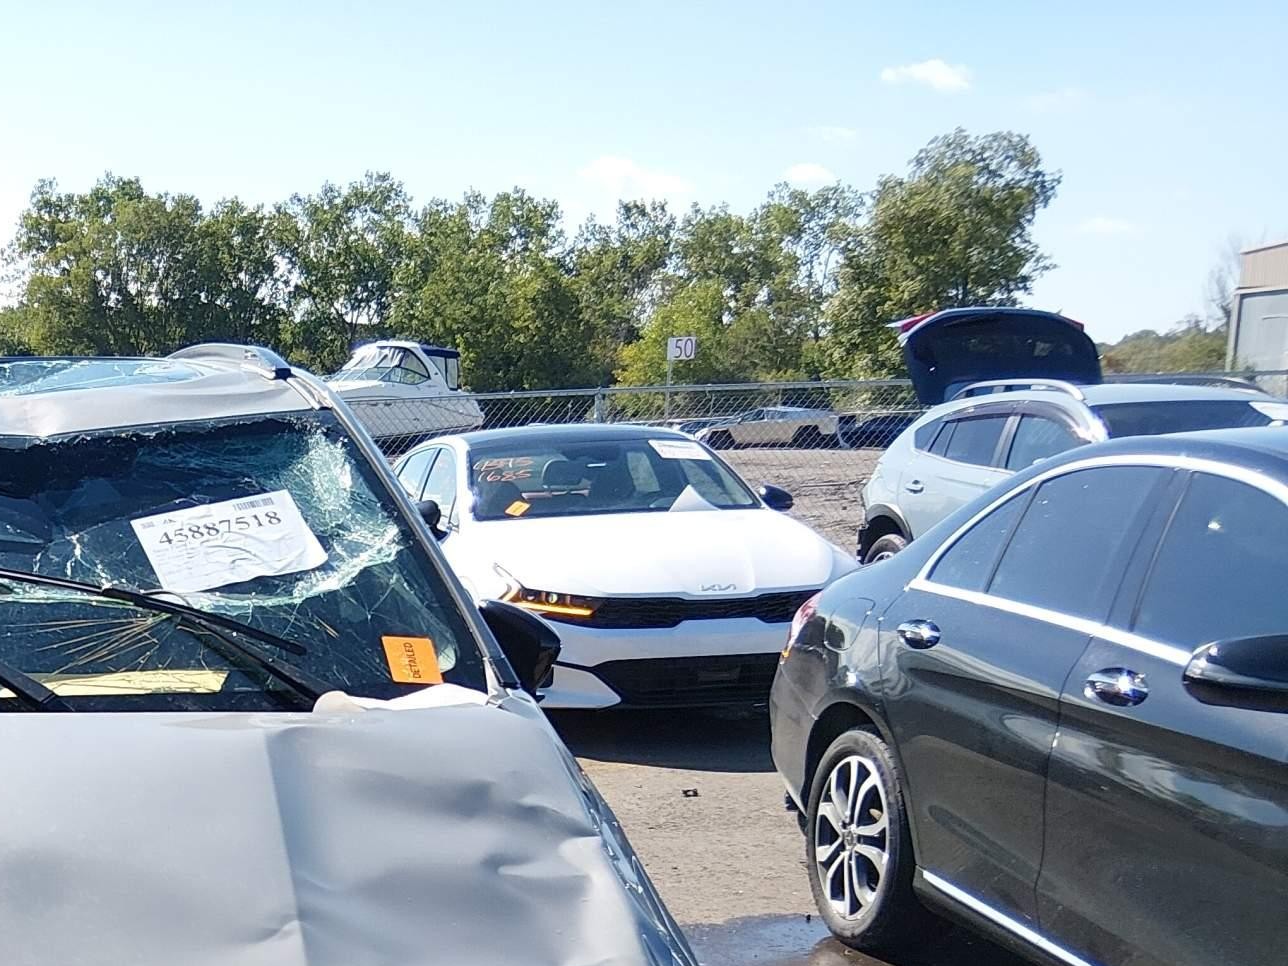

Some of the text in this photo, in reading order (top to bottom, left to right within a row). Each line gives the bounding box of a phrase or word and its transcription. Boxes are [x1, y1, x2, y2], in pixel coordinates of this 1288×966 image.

[673, 338, 694, 358] 50
[159, 511, 282, 544] 45887518
[403, 642, 422, 679] DETAILED
